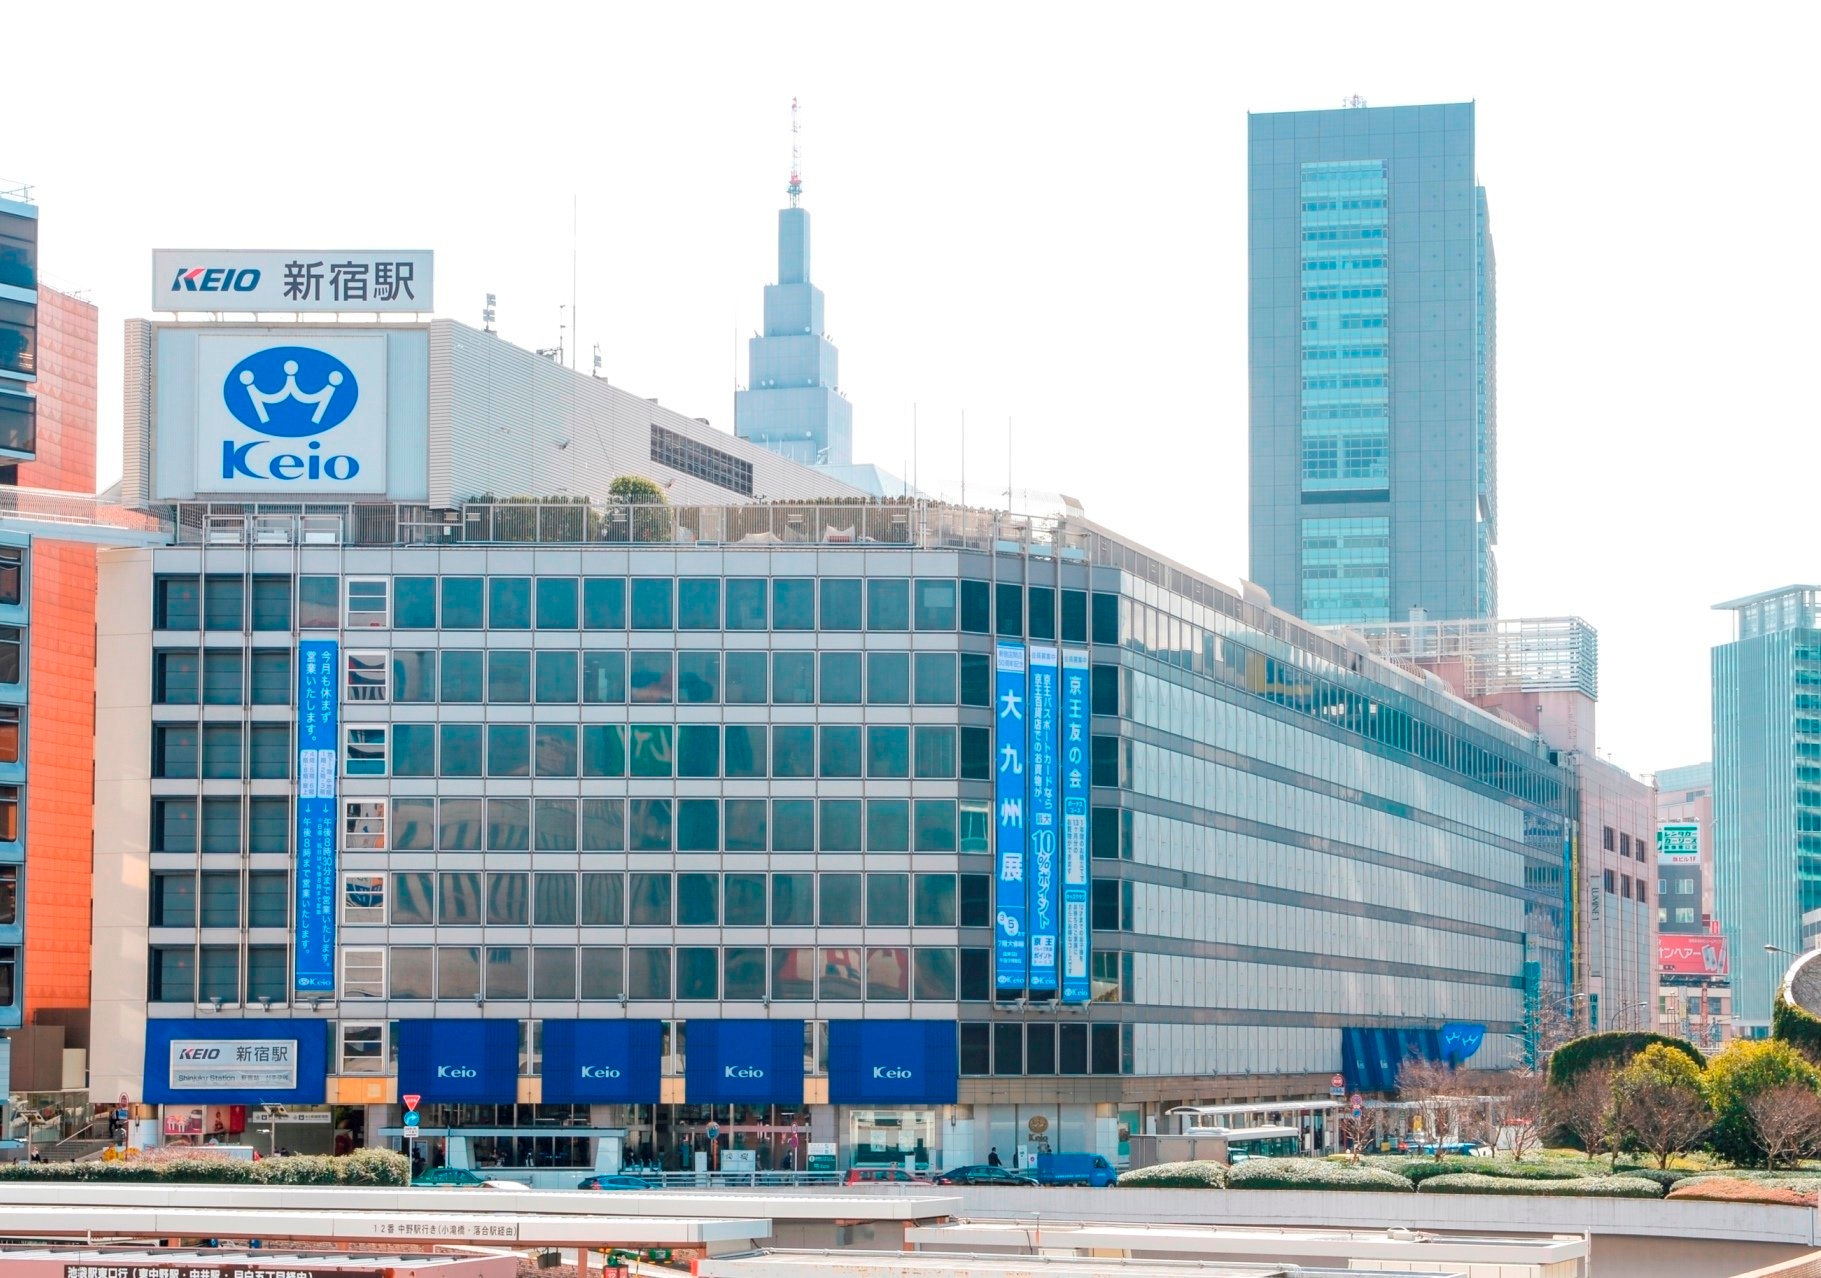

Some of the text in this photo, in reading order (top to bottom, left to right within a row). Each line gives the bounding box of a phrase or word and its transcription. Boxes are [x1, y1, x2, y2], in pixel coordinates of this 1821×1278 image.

[171, 268, 261, 292] KEIO
[283, 260, 415, 301] 新宿駅
[222, 440, 360, 481] Keio
[320, 651, 332, 724] 今月も休まず
[305, 651, 317, 742] 営業いたします。
[1069, 676, 1083, 789] 京王友の会
[1043, 674, 1053, 810] 京王パスポートカードなら
[1000, 689, 1023, 882] 大九州展
[301, 817, 312, 954] 午後8時まで営業いたします。
[321, 817, 333, 967] 午後8時30分まで営業いたします。
[1008, 919, 1015, 929] 5
[309, 978, 331, 986] Keio
[1006, 975, 1025, 984] Keio
[1040, 976, 1056, 985] Keio
[1072, 988, 1088, 997] Keio
[179, 1048, 220, 1060] KEIO
[236, 1046, 288, 1062] 新宿駅
[437, 1065, 477, 1078] Keio
[581, 1065, 620, 1078] Keio
[725, 1065, 764, 1078] Keio
[873, 1066, 912, 1079] Keio
[1029, 1133, 1048, 1141] Keio
